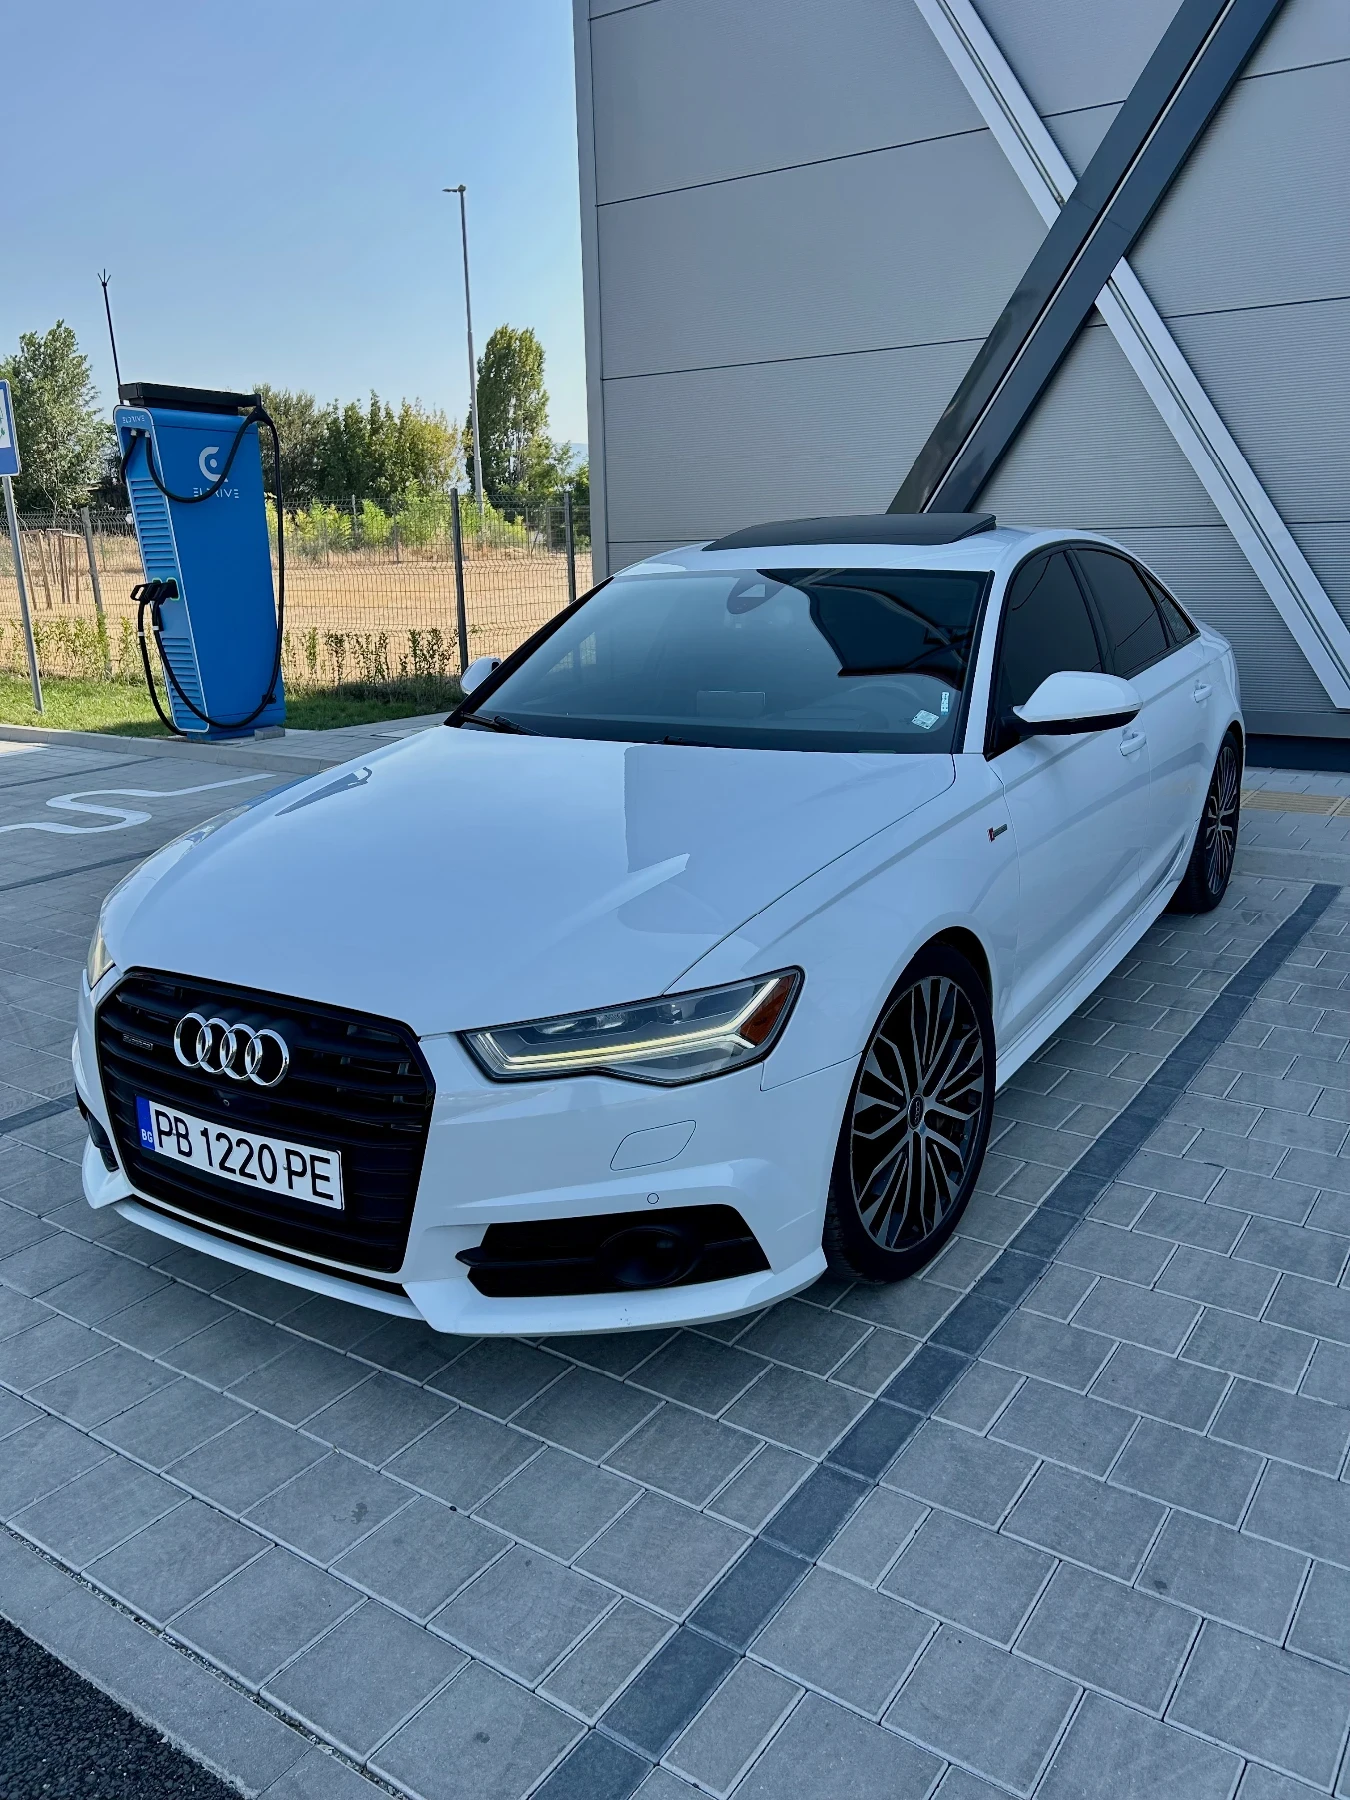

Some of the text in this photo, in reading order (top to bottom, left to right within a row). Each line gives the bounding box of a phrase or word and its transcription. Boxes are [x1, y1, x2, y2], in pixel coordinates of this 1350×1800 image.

[141, 1128, 153, 1143] BG
[154, 1109, 335, 1201] PB 1220 PE
